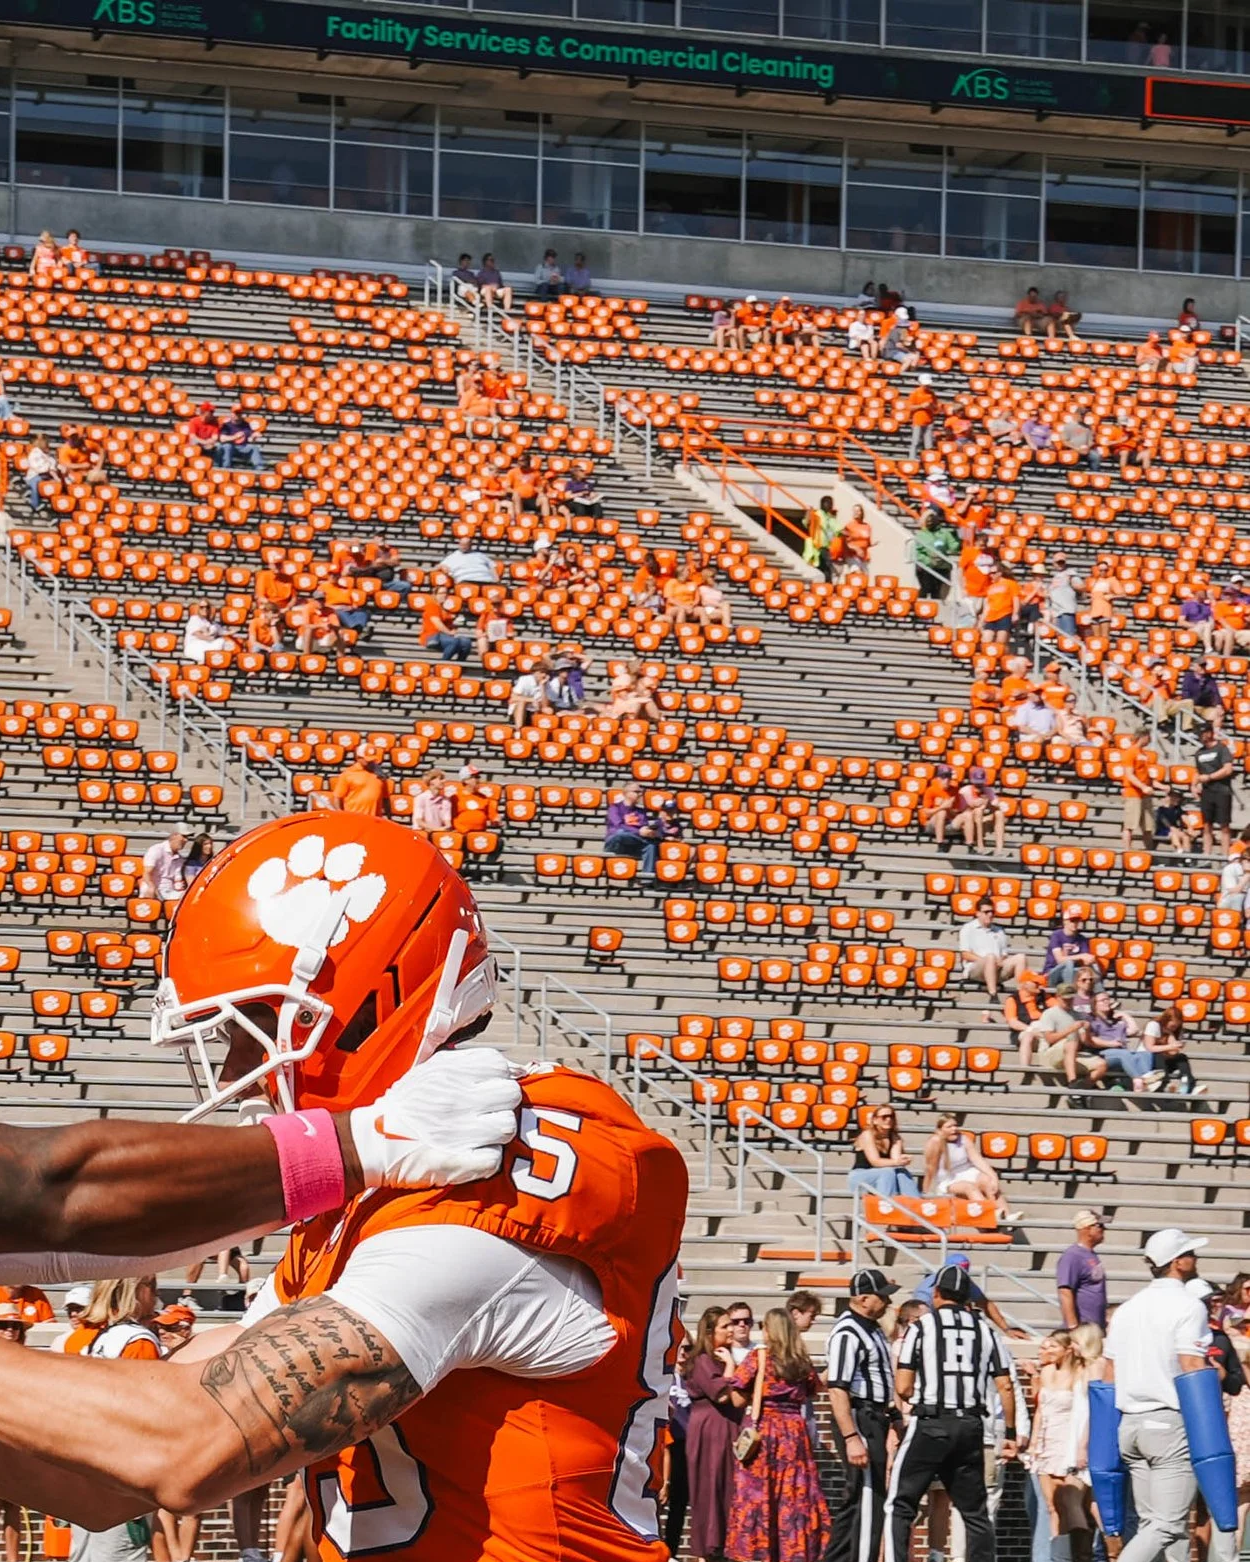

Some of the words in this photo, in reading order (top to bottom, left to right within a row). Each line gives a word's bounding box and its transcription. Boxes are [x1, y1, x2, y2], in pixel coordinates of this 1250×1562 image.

[327, 16, 419, 51] Facility
[423, 25, 531, 55] Services
[535, 36, 555, 57] &
[560, 38, 718, 71] Commercial
[722, 52, 835, 88] Cleaning
[951, 73, 1009, 100] ABS
[942, 1328, 977, 1373] H
